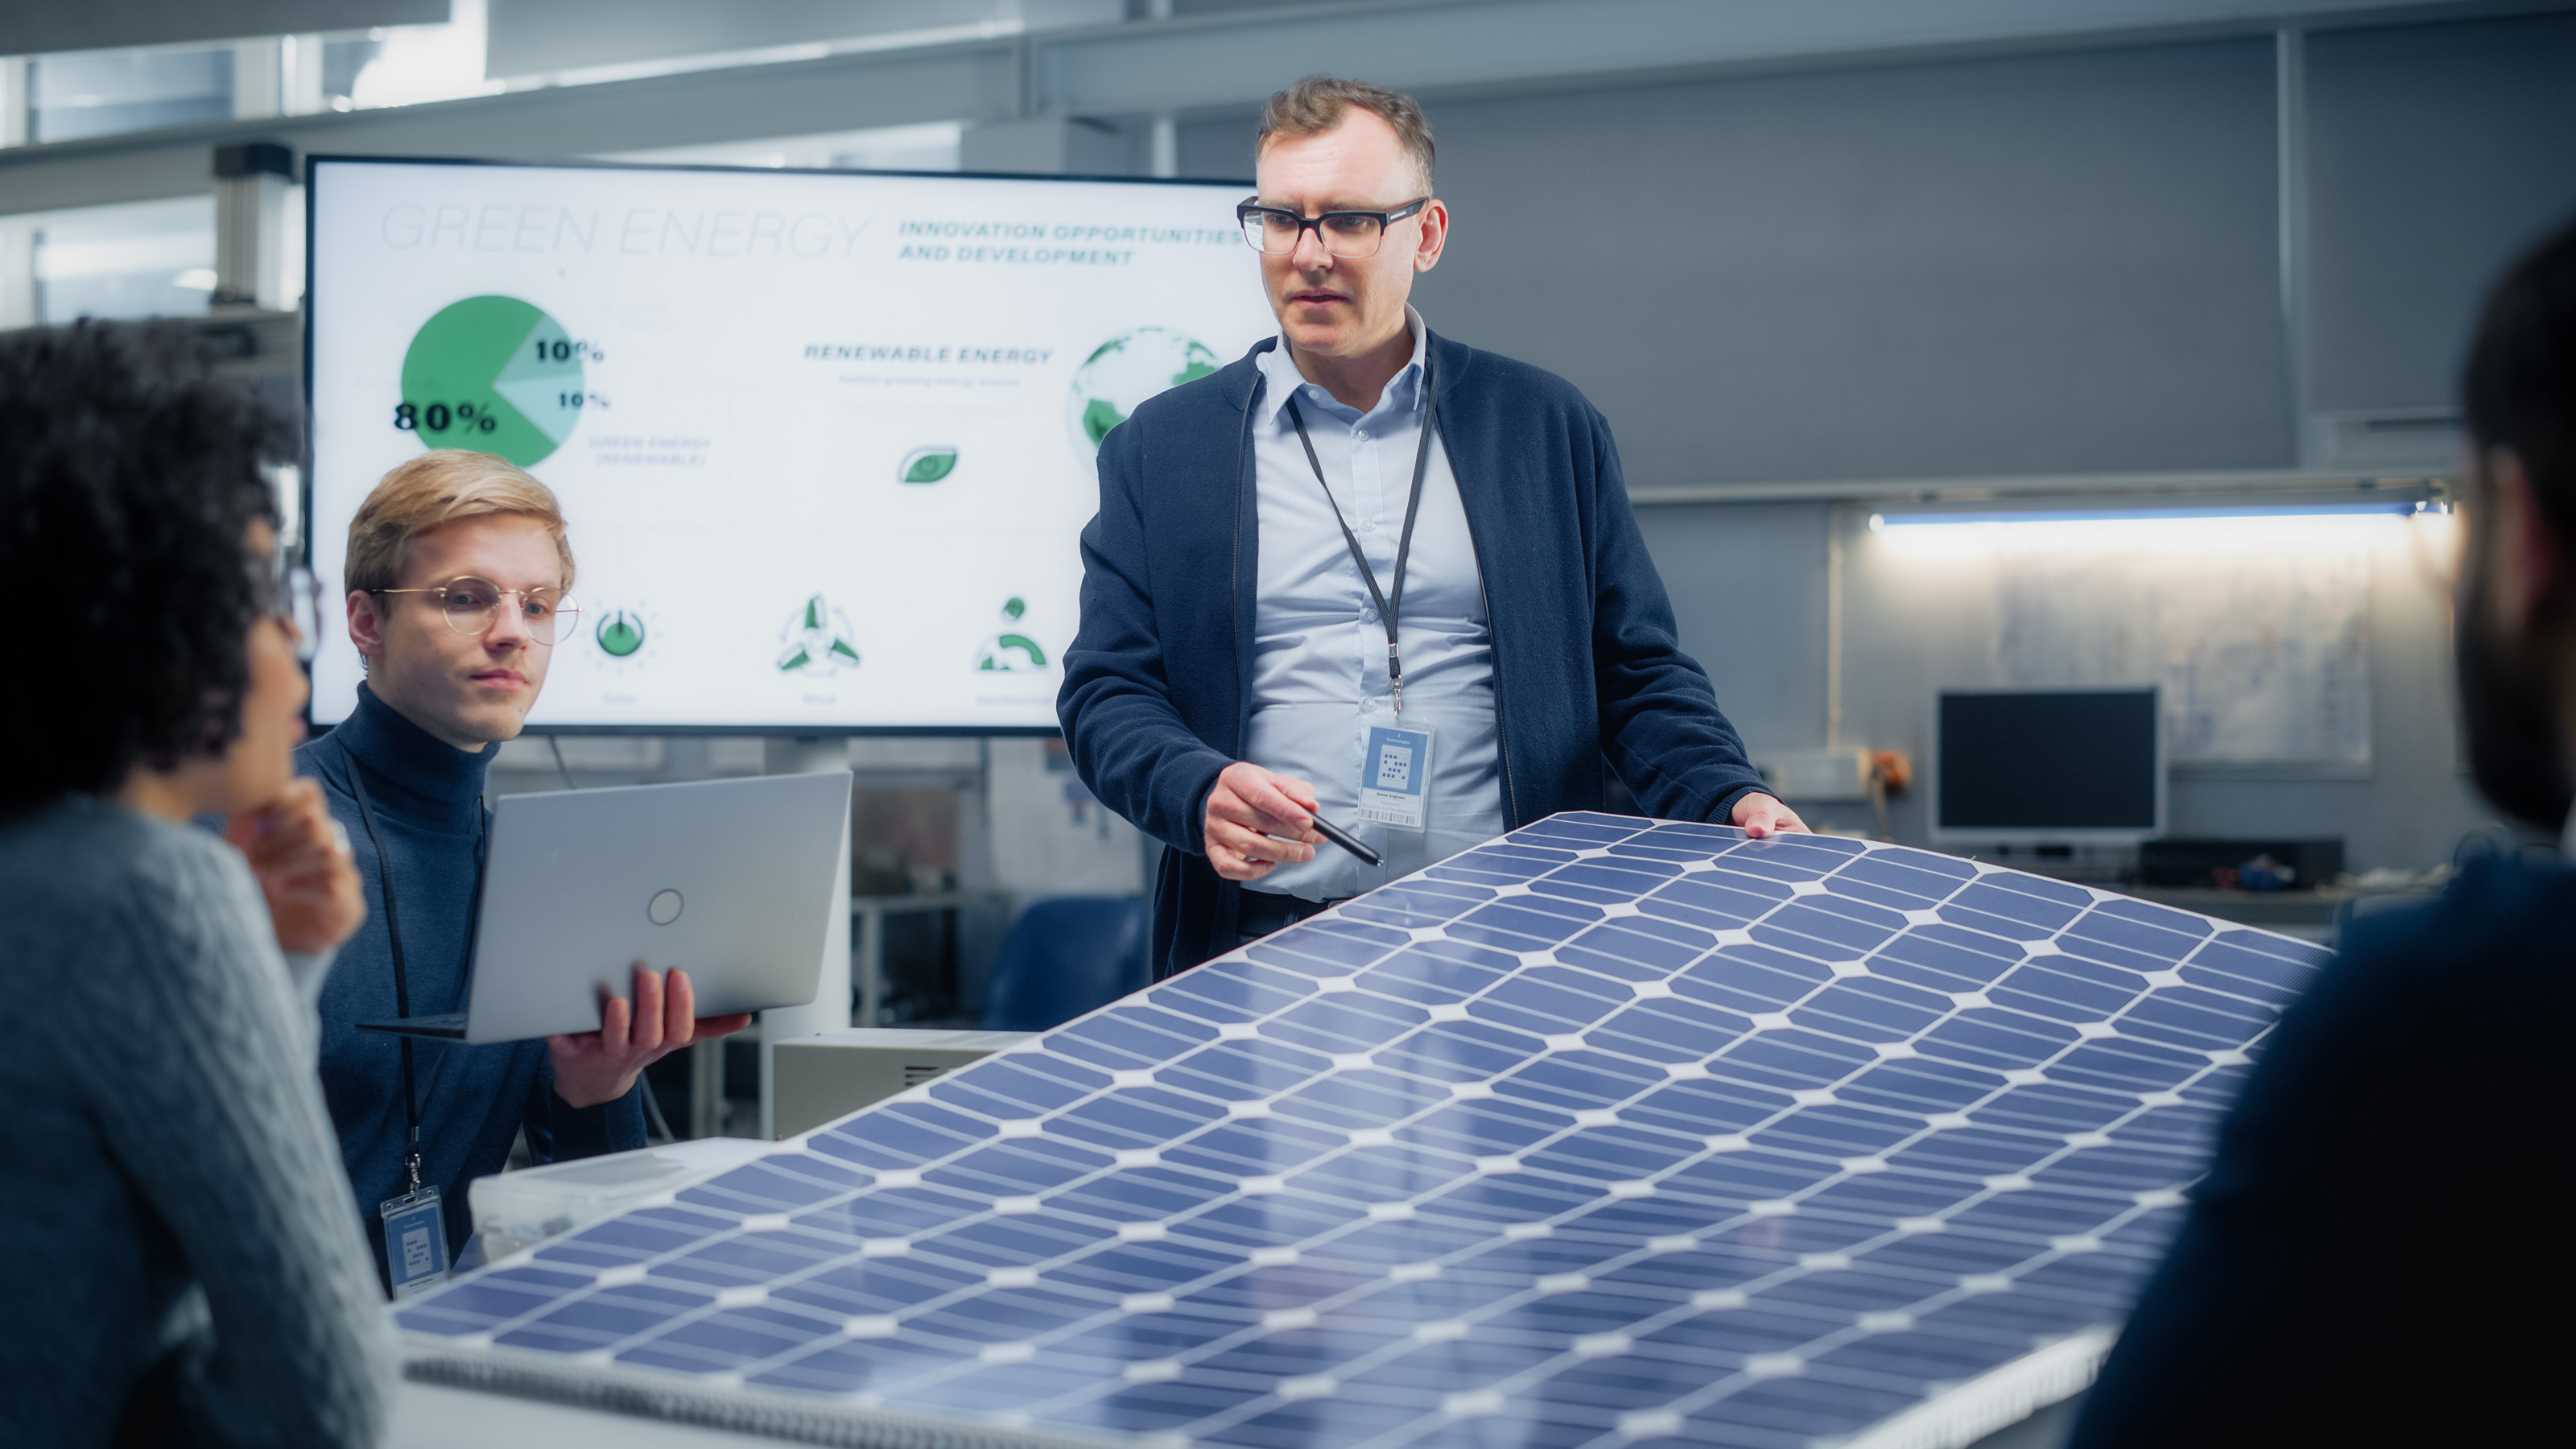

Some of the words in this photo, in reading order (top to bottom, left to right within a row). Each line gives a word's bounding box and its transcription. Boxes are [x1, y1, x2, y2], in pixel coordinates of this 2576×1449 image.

[380, 201, 601, 253] GREEN
[617, 207, 875, 259] ENERGY
[898, 219, 1046, 242] INNOVATION
[1051, 224, 1245, 246] OPPORTUNITIES
[898, 244, 951, 262] AND
[956, 246, 1134, 267] DEVELOPMENT
[535, 338, 605, 364] 10%
[803, 343, 953, 365] RENEWABLE
[957, 346, 1055, 366] ENERGY
[393, 402, 497, 433] 80%
